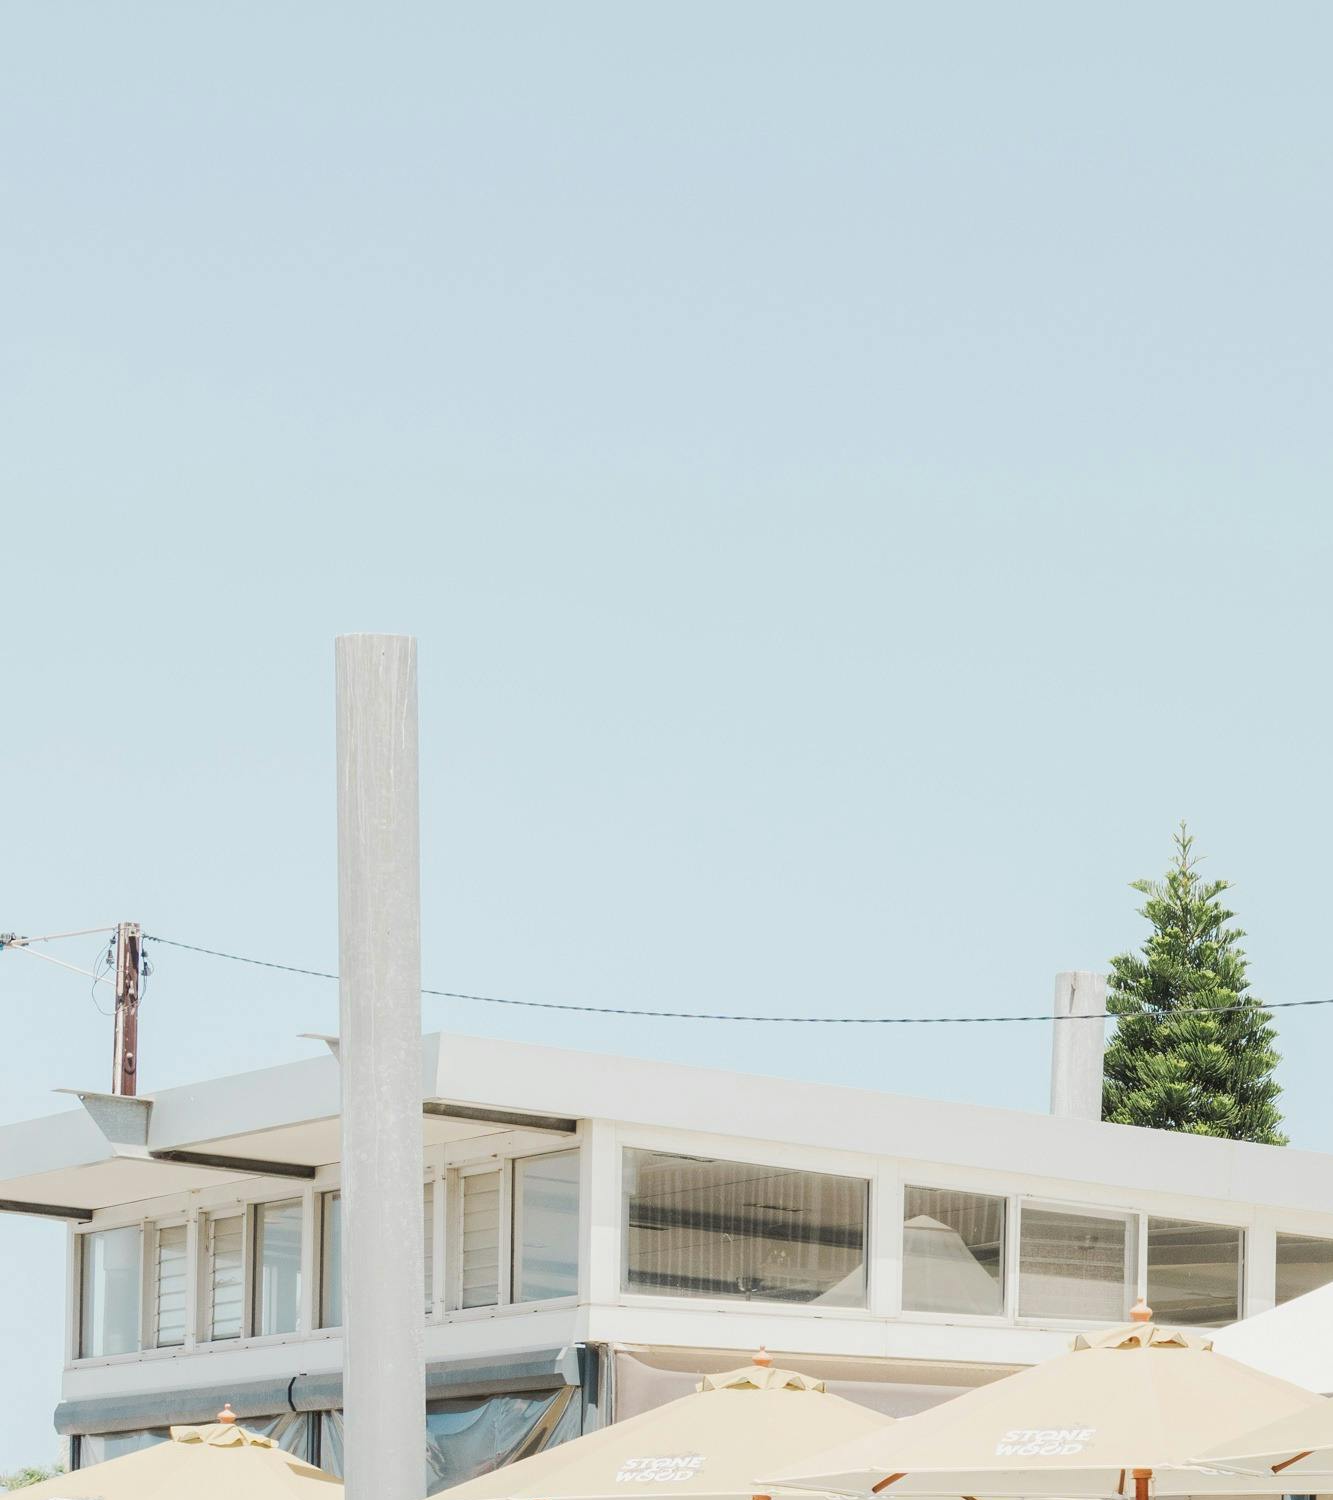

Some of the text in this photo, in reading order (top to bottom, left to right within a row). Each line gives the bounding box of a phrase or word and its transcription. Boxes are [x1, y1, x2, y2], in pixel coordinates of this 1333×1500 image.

[1002, 1429, 1096, 1442] STONE
[996, 1443, 1083, 1456] WOOD
[621, 1457, 706, 1470] STONE
[616, 1470, 694, 1482] WOOD
